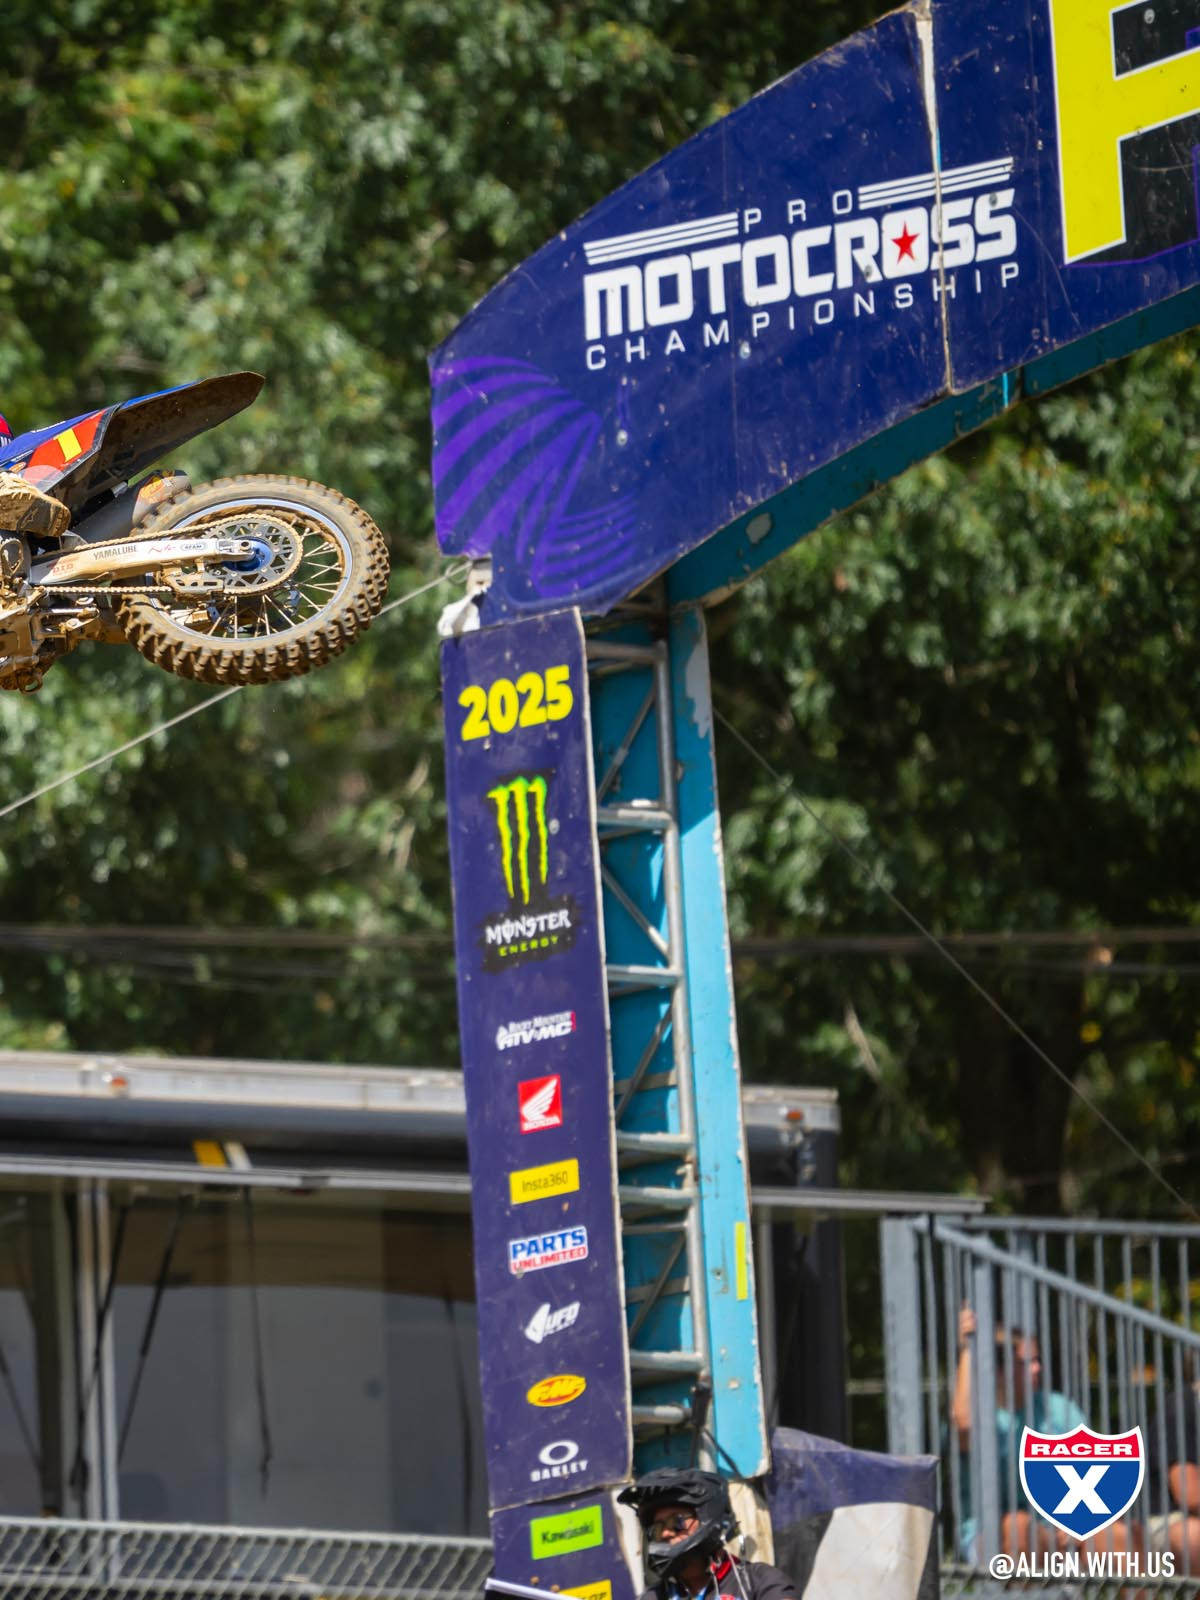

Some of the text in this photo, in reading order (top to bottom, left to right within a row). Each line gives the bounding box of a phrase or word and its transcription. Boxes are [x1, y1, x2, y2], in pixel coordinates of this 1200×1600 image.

[745, 189, 853, 233] PRO
[584, 188, 1017, 342] MOTOCROSS
[586, 262, 1020, 371] CHAMPIONSHIP
[93, 544, 137, 561] YAMALUBE
[457, 664, 574, 741] 2025
[485, 908, 572, 946] MONSTER
[498, 934, 559, 957] ENERGY
[522, 1171, 568, 1192] Insta360
[512, 1229, 586, 1260] PARTS
[512, 1246, 587, 1272] UNLIMITED
[530, 1460, 589, 1482] OAKLEY
[542, 1521, 595, 1545] Kawasaki
